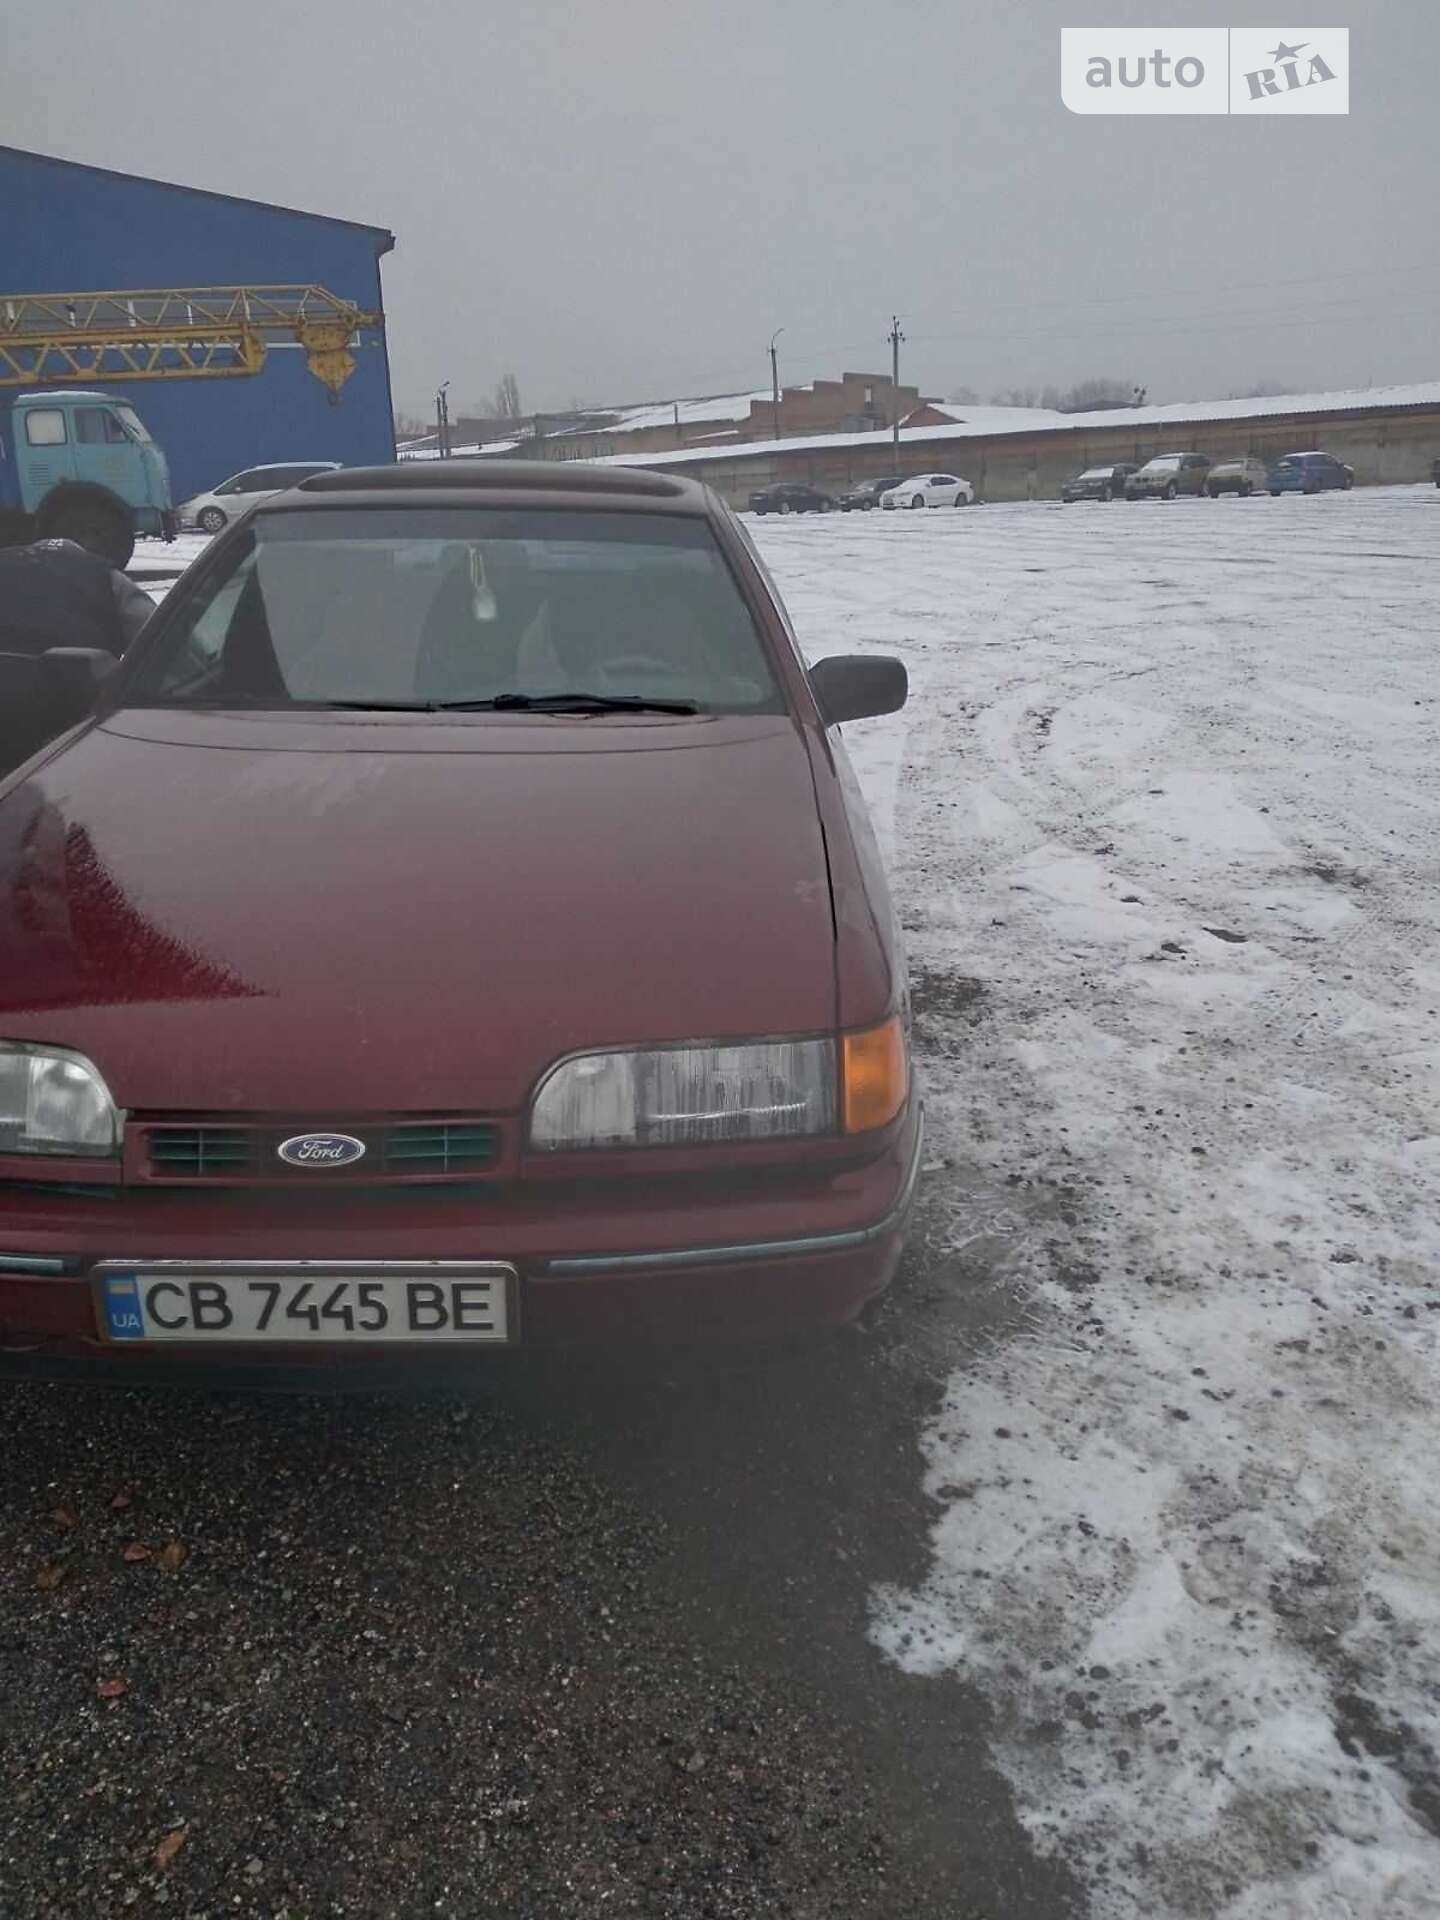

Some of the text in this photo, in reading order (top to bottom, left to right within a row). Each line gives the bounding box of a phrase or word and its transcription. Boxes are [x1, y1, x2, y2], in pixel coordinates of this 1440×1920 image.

[298, 1140, 344, 1159] Ford
[145, 1282, 495, 1331] CB 7445 BE
[111, 1313, 141, 1328] UA
